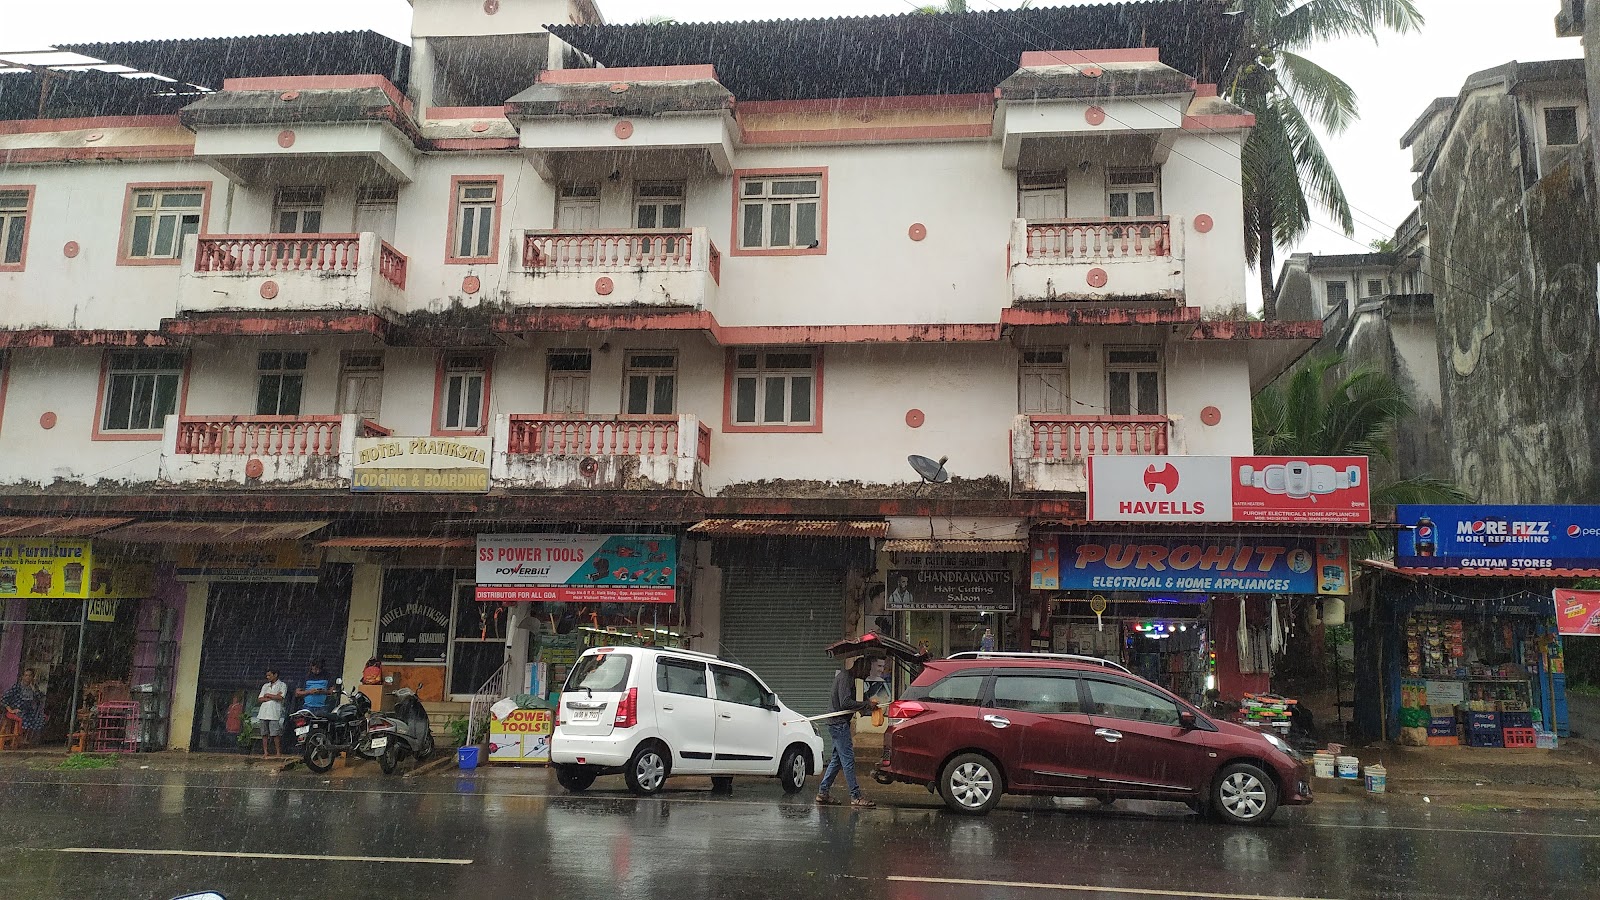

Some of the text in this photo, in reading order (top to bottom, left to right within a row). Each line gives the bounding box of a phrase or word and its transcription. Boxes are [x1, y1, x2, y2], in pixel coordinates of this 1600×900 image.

[359, 439, 486, 464] HOTEL PRATIKSHA
[354, 474, 486, 487] LODGING & BOARDING
[1119, 502, 1205, 514] HAVELLS
[1456, 521, 1550, 536] MORE FIZZ
[18, 544, 82, 558] Furniture
[479, 548, 584, 562] SS POWER TOOLS
[1074, 544, 1287, 572] PUROHIT
[1461, 559, 1552, 568] GAUTAM STORES
[917, 571, 1011, 583] CHANDRAKANT'S
[1092, 576, 1291, 590] ELECTRICAL & HOME APPLIANCES
[958, 586, 994, 595] Cutting
[947, 594, 981, 602] Saloon
[89, 599, 114, 616] XEROX
[380, 603, 449, 628] HOTEL PRATIKSHA
[381, 632, 404, 643] LODGING
[418, 632, 446, 644] BOARDING
[506, 711, 550, 722] POWER
[502, 722, 541, 732] TOOLS
